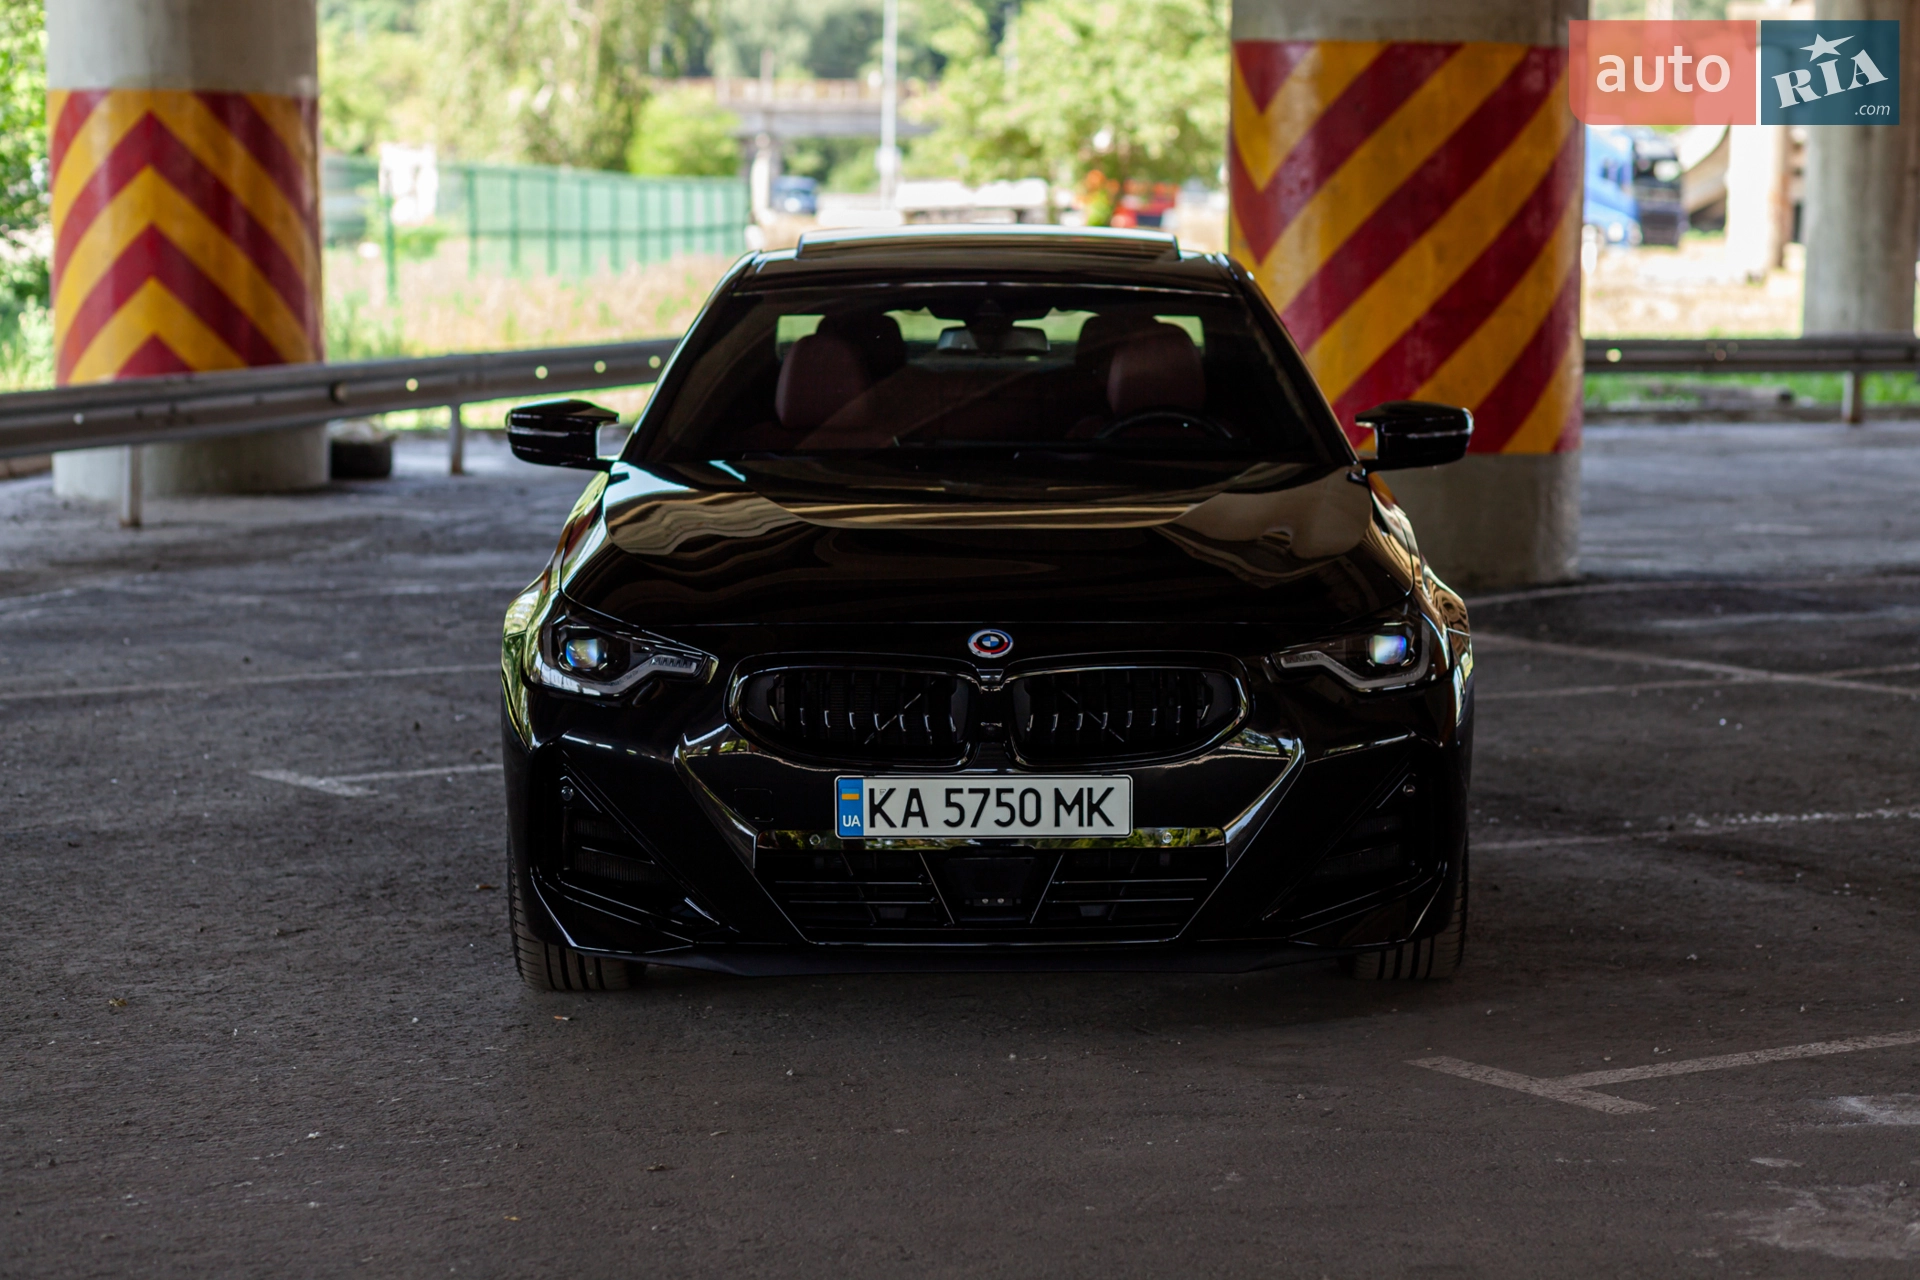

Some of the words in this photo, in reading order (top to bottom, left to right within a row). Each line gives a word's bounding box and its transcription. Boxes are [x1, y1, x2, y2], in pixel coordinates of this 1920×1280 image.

[869, 787, 929, 828] KA
[943, 787, 1042, 828] 5750
[1054, 787, 1115, 828] MK
[842, 815, 861, 827] UA
